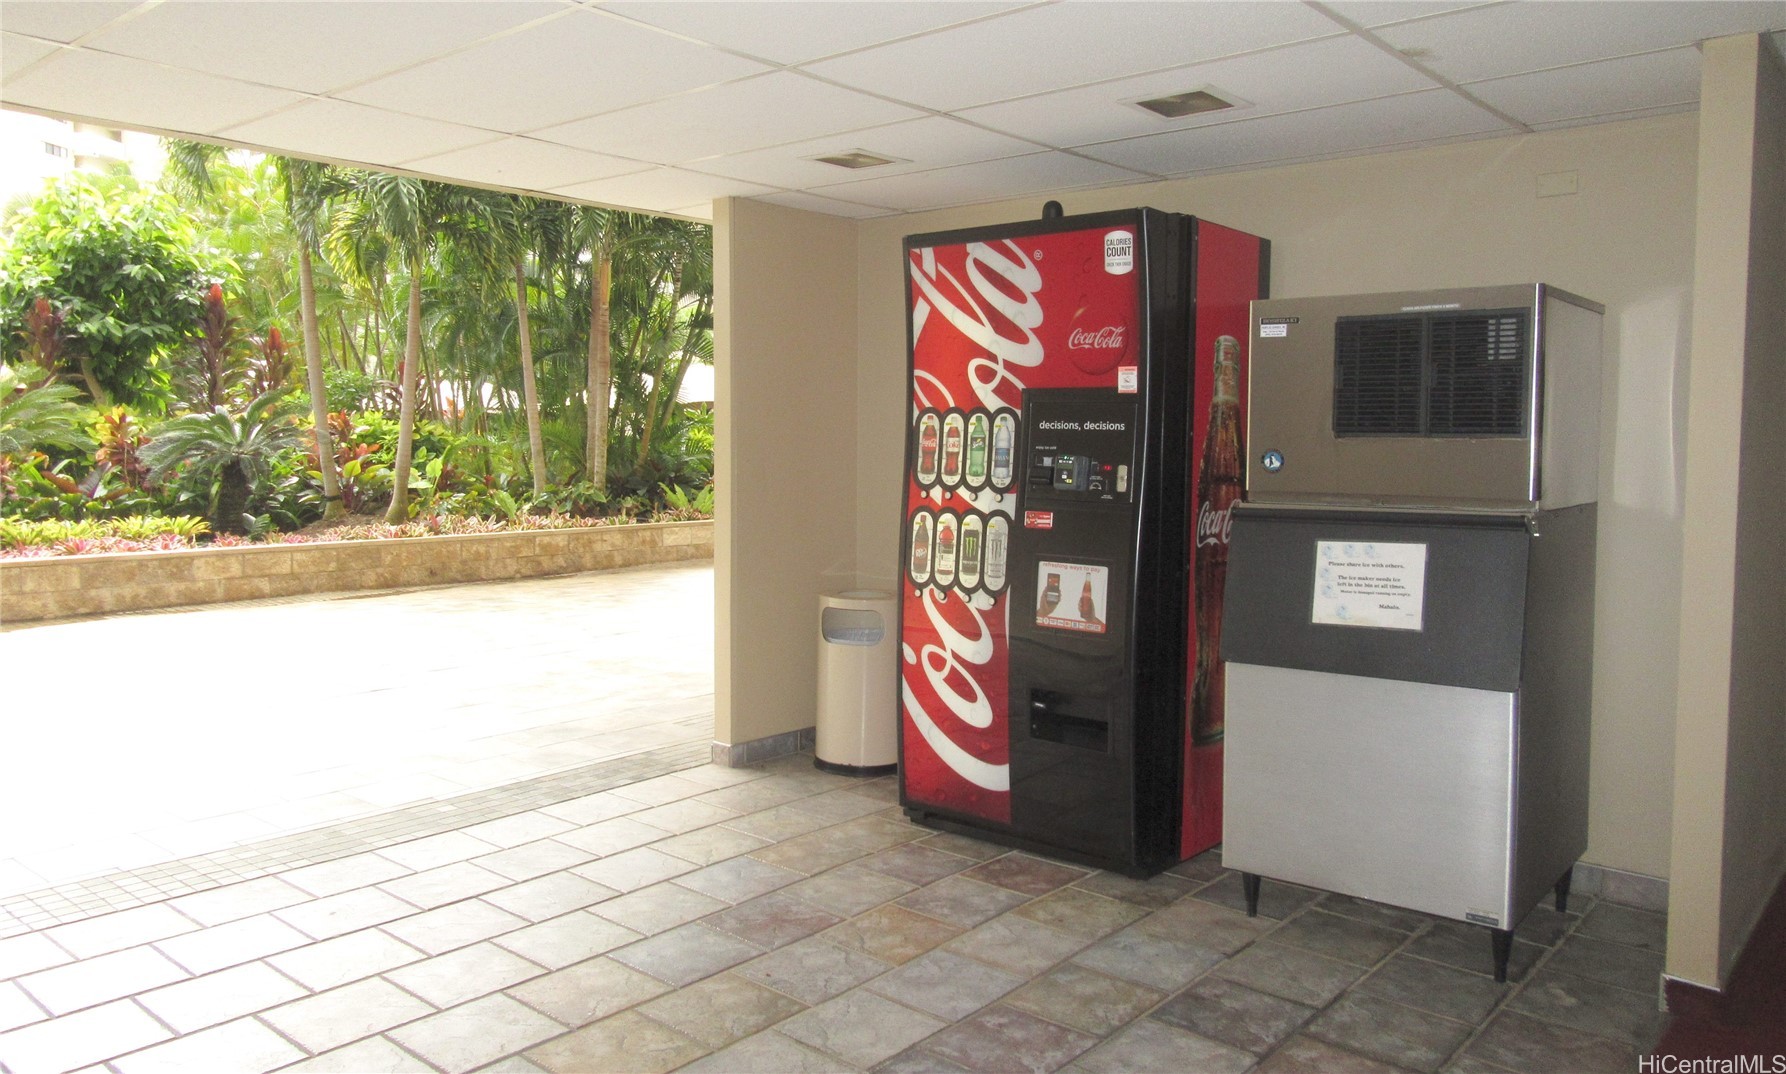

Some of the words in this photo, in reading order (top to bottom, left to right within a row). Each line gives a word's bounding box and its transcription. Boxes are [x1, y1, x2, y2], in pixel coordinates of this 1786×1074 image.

[1106, 238, 1131, 246] CALORIES
[1106, 246, 1131, 257] COUNT
[1069, 326, 1126, 349] Coca-Cola
[1039, 420, 1081, 431] decisions,
[1083, 421, 1125, 431] decisions
[1197, 499, 1242, 548] Coca-C
[1042, 562, 1068, 570] refreshing
